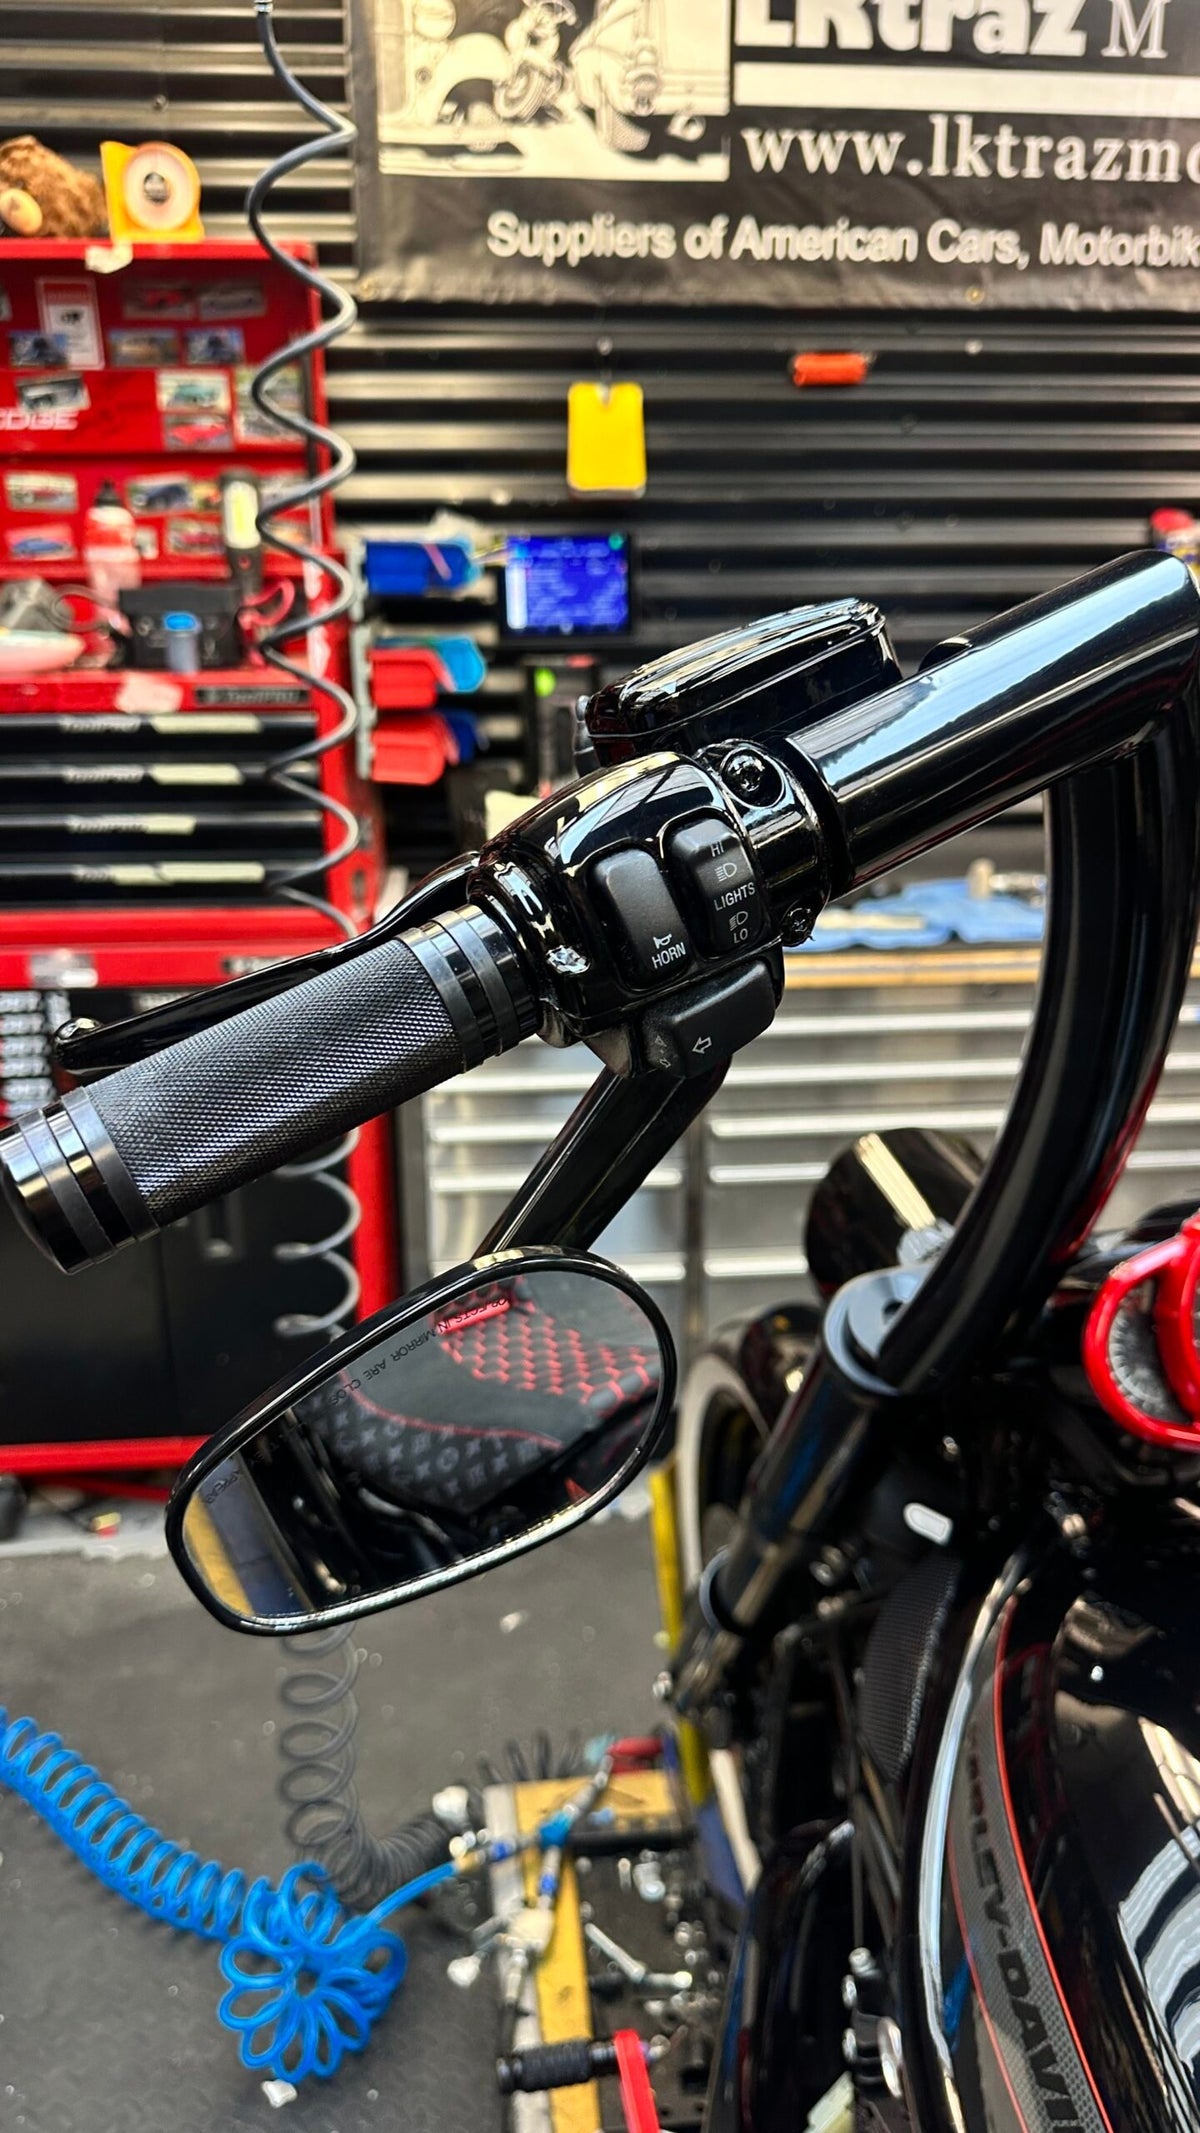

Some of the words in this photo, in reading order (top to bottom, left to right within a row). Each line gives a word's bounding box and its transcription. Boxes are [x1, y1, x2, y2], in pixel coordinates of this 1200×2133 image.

[487, 210, 677, 267] Suppliers
[683, 213, 729, 260] of
[729, 214, 918, 262] American
[926, 218, 1029, 270] Cars,
[711, 841, 724, 857] HI
[714, 882, 755, 911] LIGHTS
[734, 928, 748, 943] LO
[652, 942, 686, 968] HORN
[455, 1297, 508, 1323] OBECTS
[437, 1317, 452, 1334] IN
[390, 1328, 436, 1362] MIRROR
[364, 1358, 387, 1381] ARE
[327, 1379, 361, 1407] CLOS
